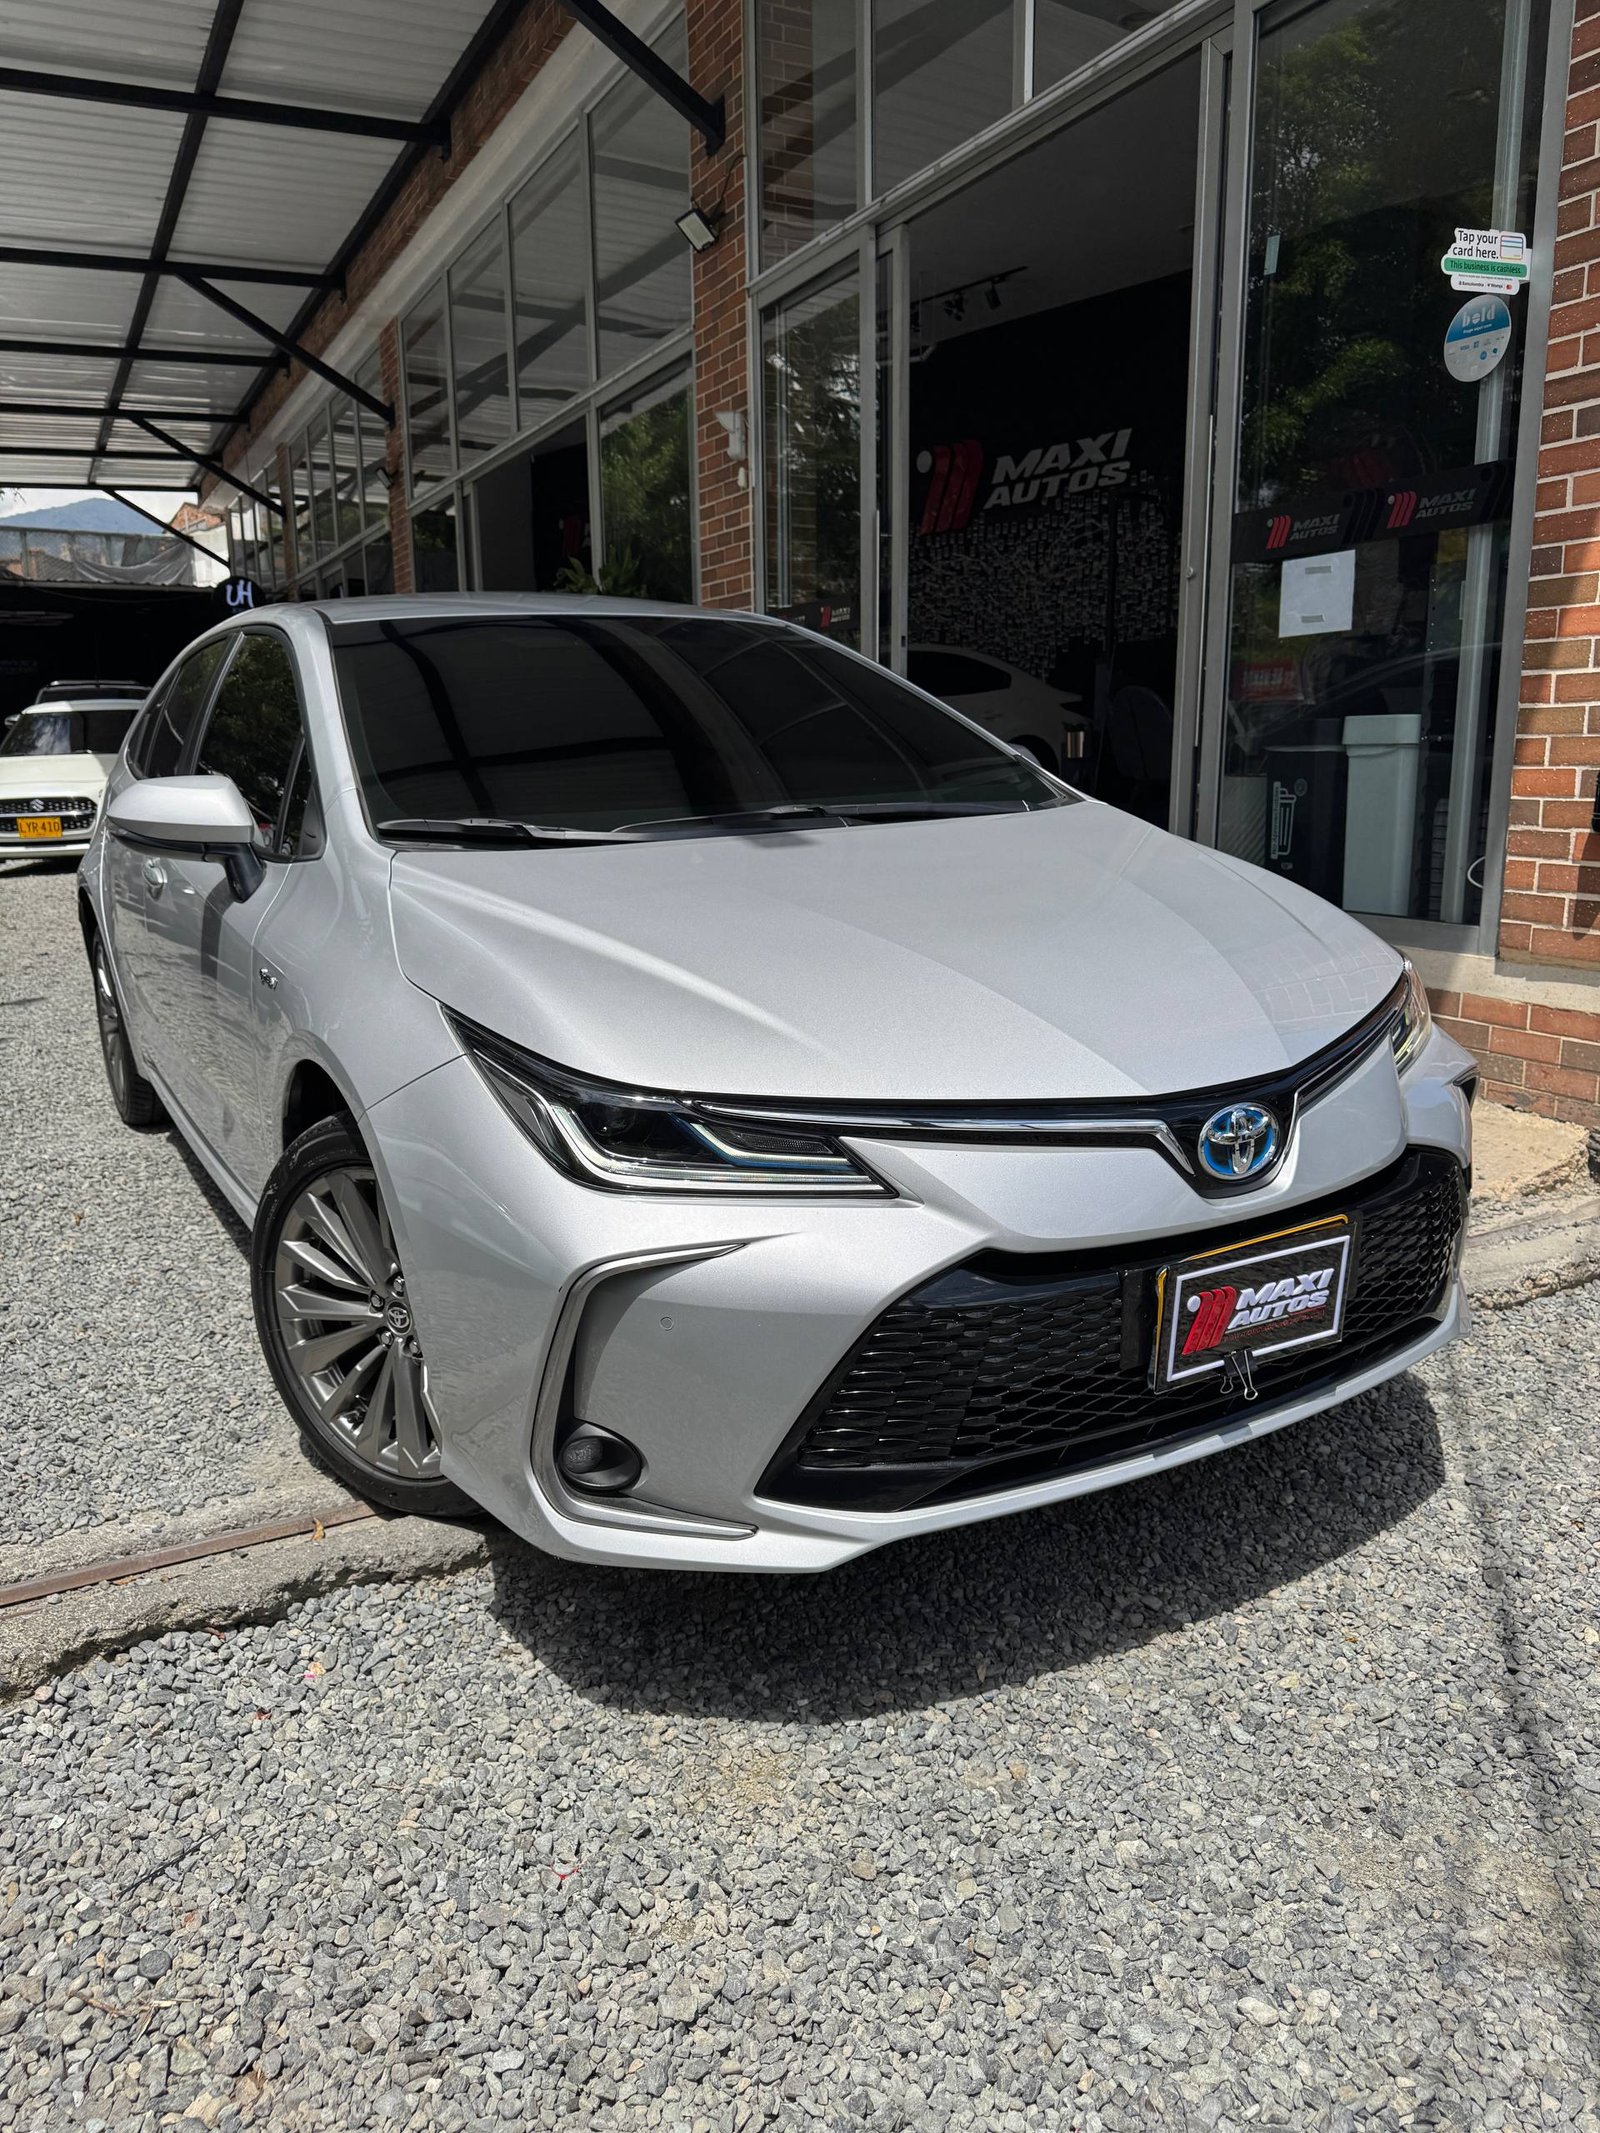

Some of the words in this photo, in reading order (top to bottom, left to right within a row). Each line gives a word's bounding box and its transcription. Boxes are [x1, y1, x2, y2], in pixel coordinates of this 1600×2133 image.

[1458, 230, 1474, 245] Tap
[1477, 233, 1498, 245] your
[1452, 245, 1473, 257] card
[1475, 247, 1499, 259] here.
[1450, 260, 1463, 269] This
[1464, 262, 1489, 271] business
[1462, 304, 1496, 327] bold
[991, 428, 1132, 484] MAXI
[983, 461, 1130, 510] AUTOS
[1419, 488, 1477, 509] MAXI
[1415, 500, 1474, 519] AUTOS
[1292, 513, 1341, 532] MAXI
[1289, 525, 1339, 542] AUTOS
[19, 821, 38, 833] LYR
[41, 821, 60, 833] 410
[1235, 1268, 1335, 1310] MAXI
[1227, 1289, 1330, 1330] AUTOS
